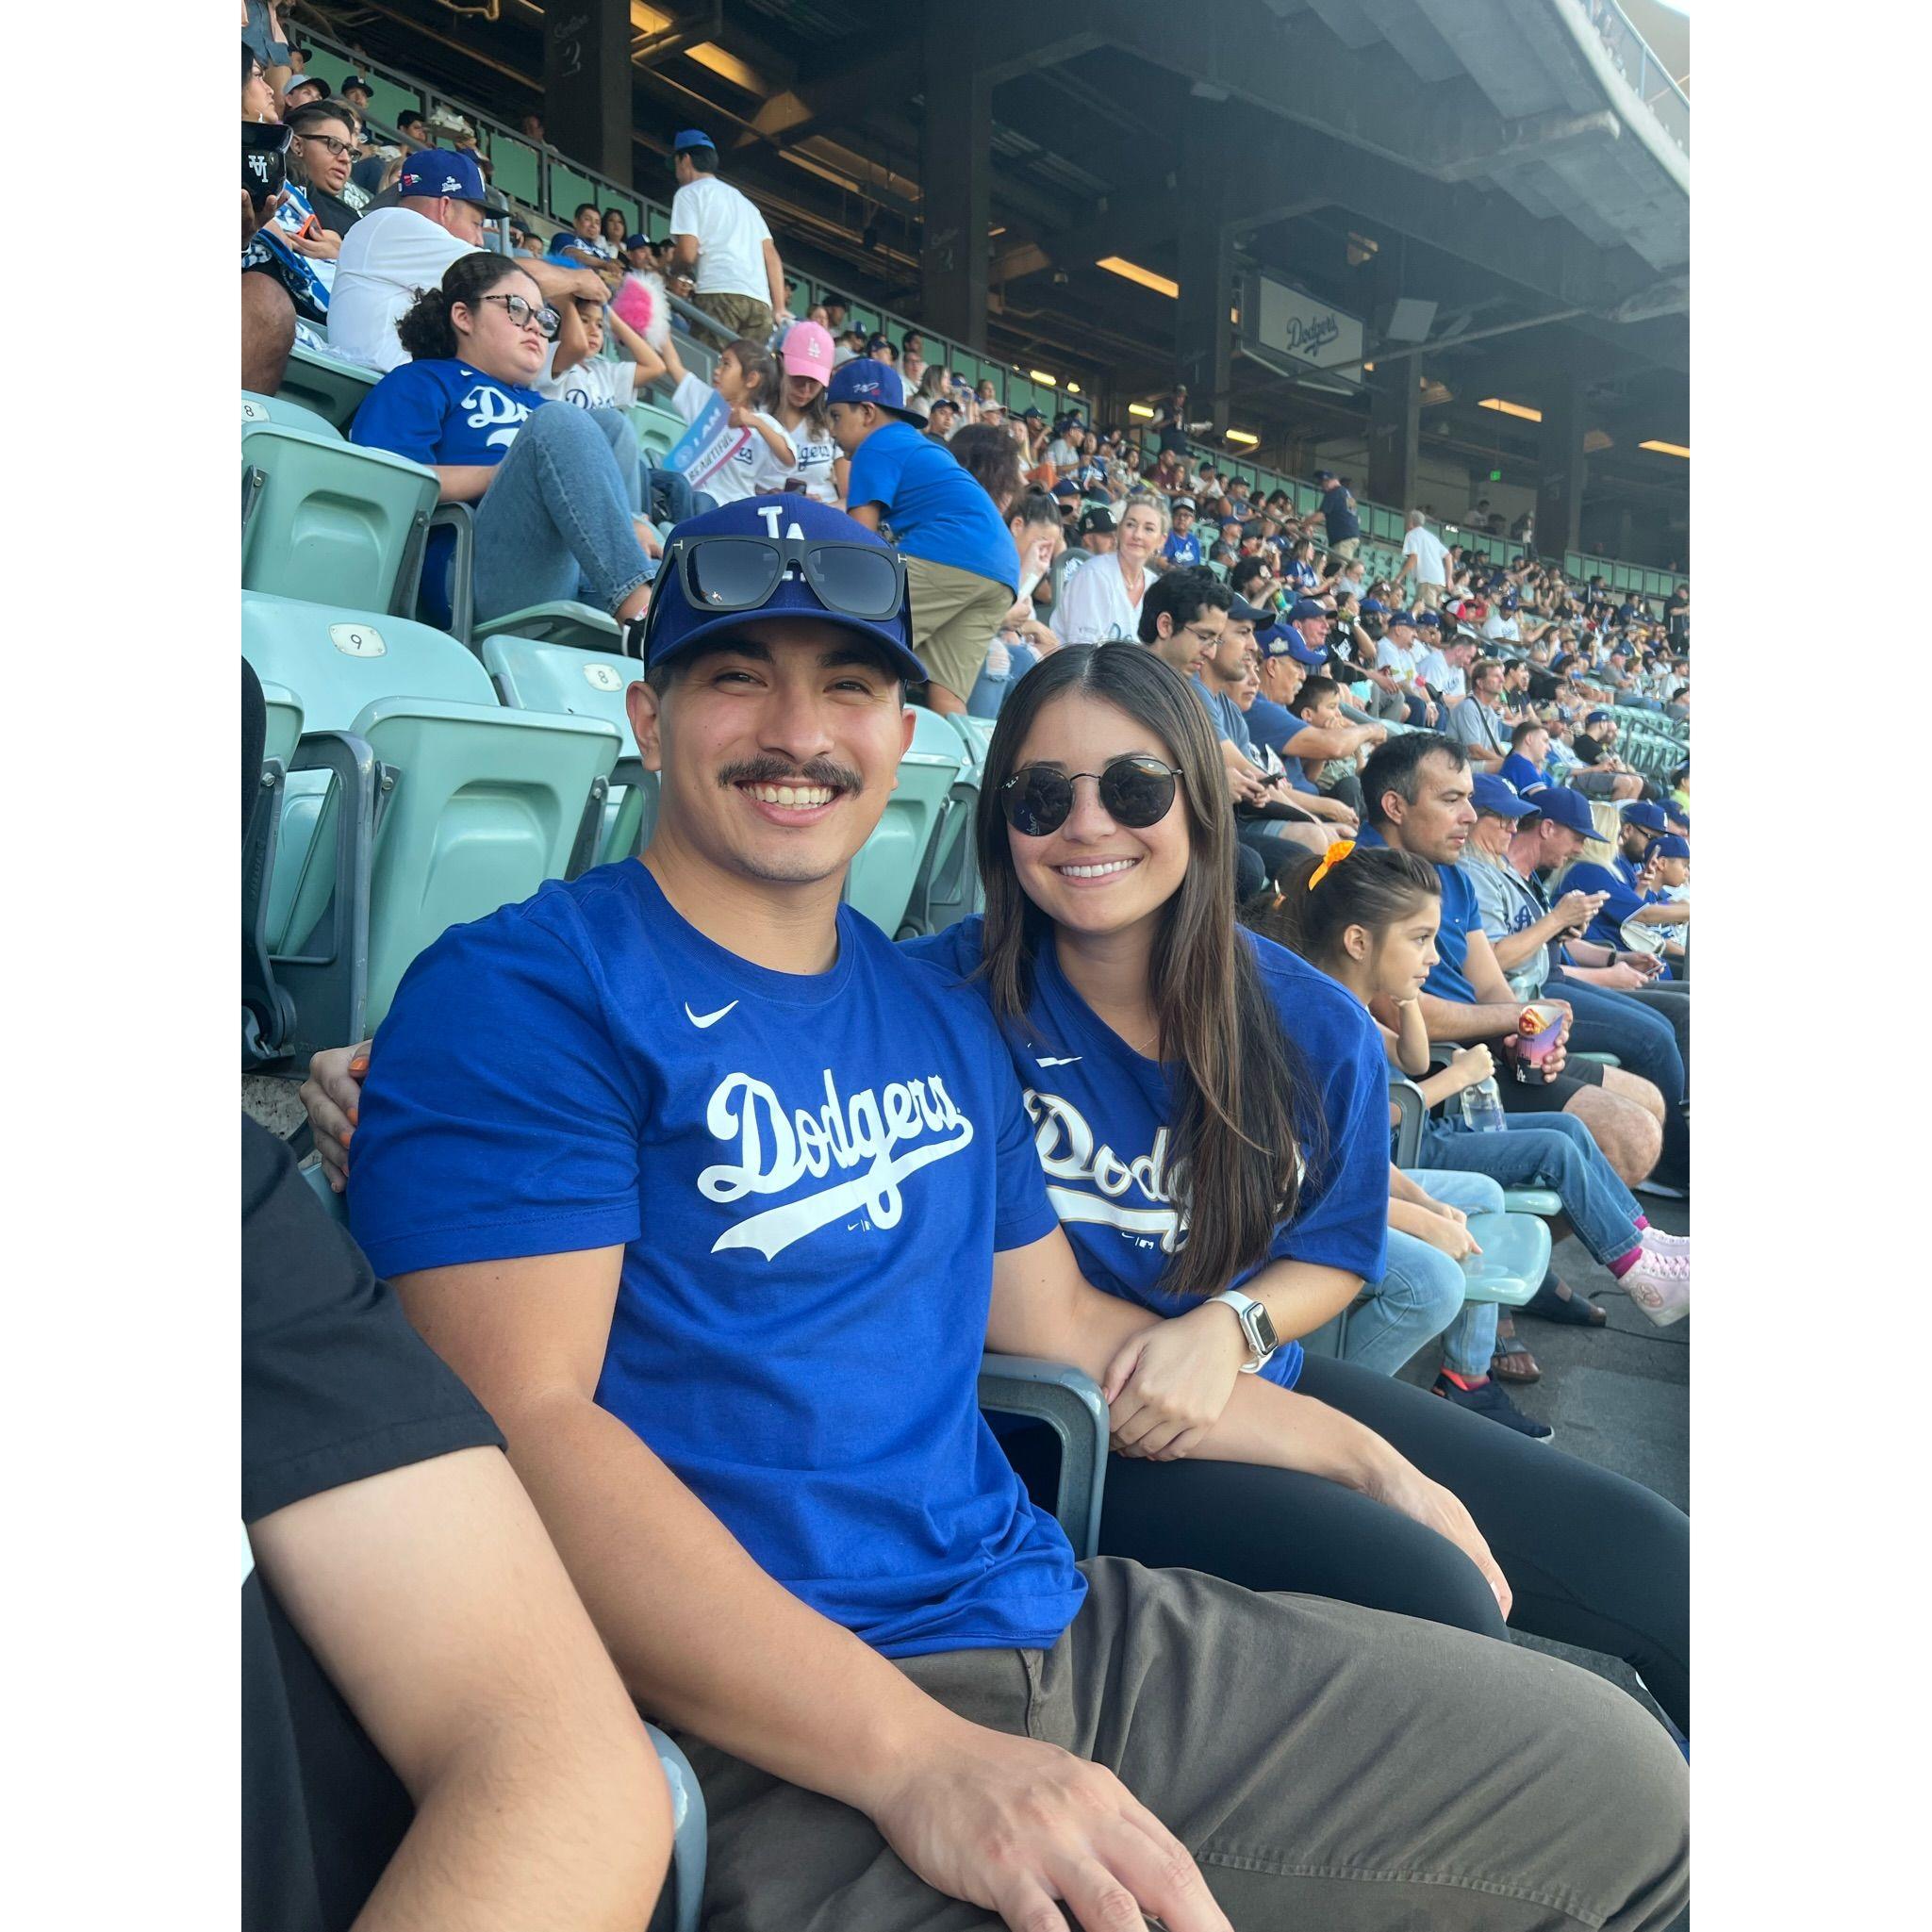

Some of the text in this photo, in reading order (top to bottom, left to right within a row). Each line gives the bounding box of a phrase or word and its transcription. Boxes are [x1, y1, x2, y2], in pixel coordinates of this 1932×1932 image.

[244, 405, 255, 417] 8
[350, 634, 362, 650] 9
[597, 670, 609, 685] 8
[697, 1069, 974, 1230] Dodgers
